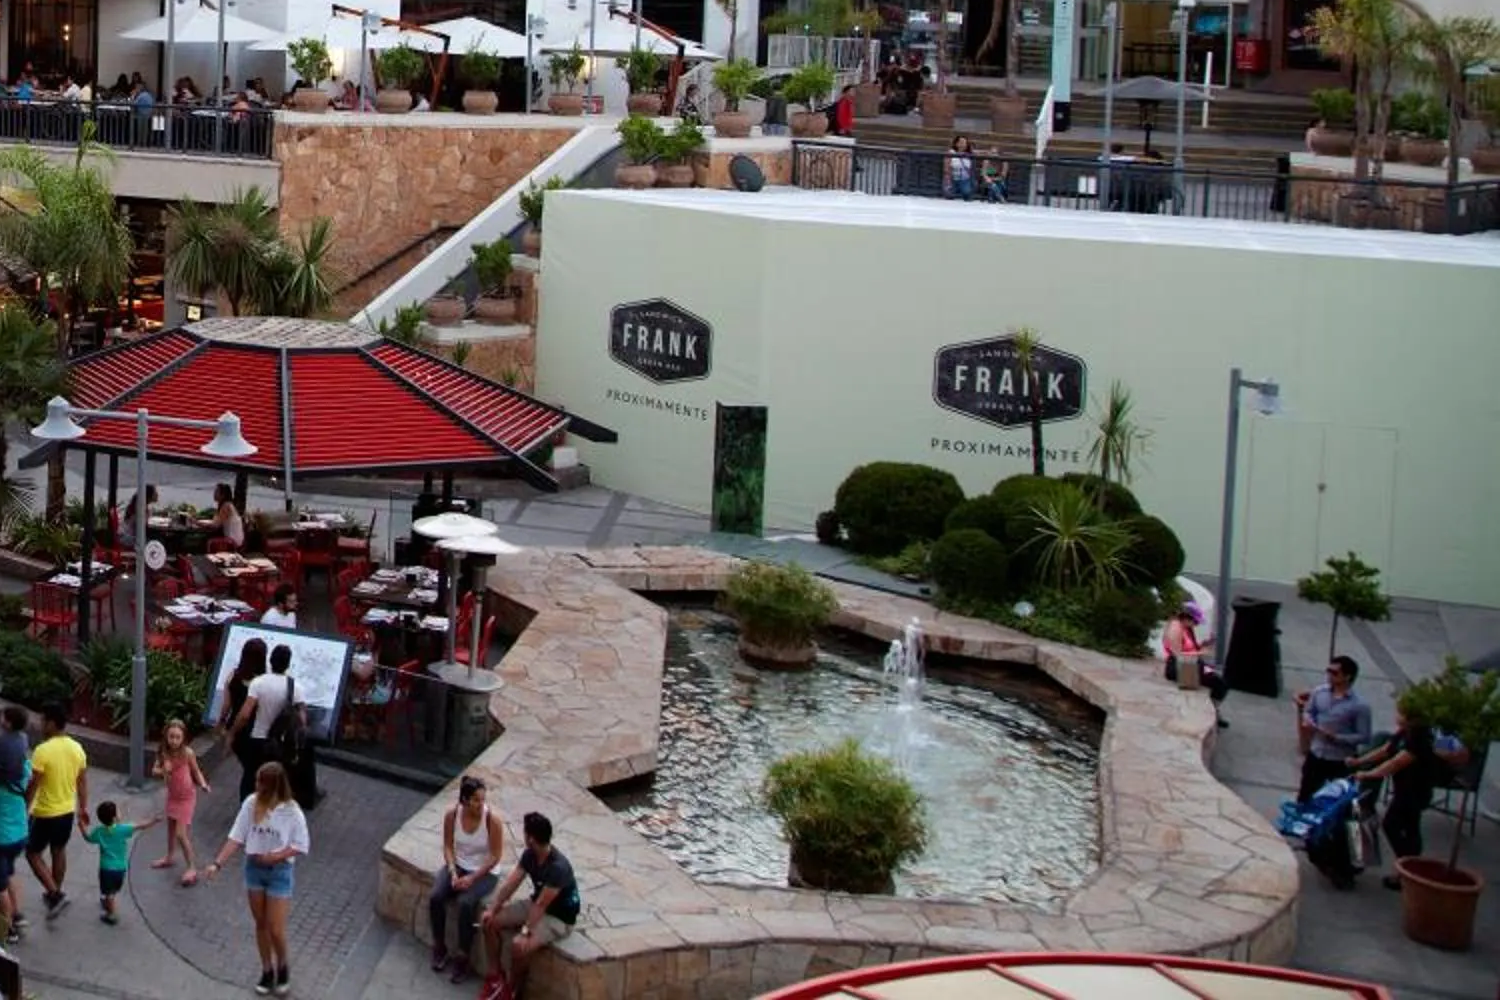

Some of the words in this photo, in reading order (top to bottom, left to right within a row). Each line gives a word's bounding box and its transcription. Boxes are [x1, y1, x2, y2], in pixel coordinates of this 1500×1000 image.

[623, 322, 698, 361] FRANK
[606, 388, 708, 421] PROXIMAMENTE
[931, 436, 1081, 463] PROXIMAMNTE
